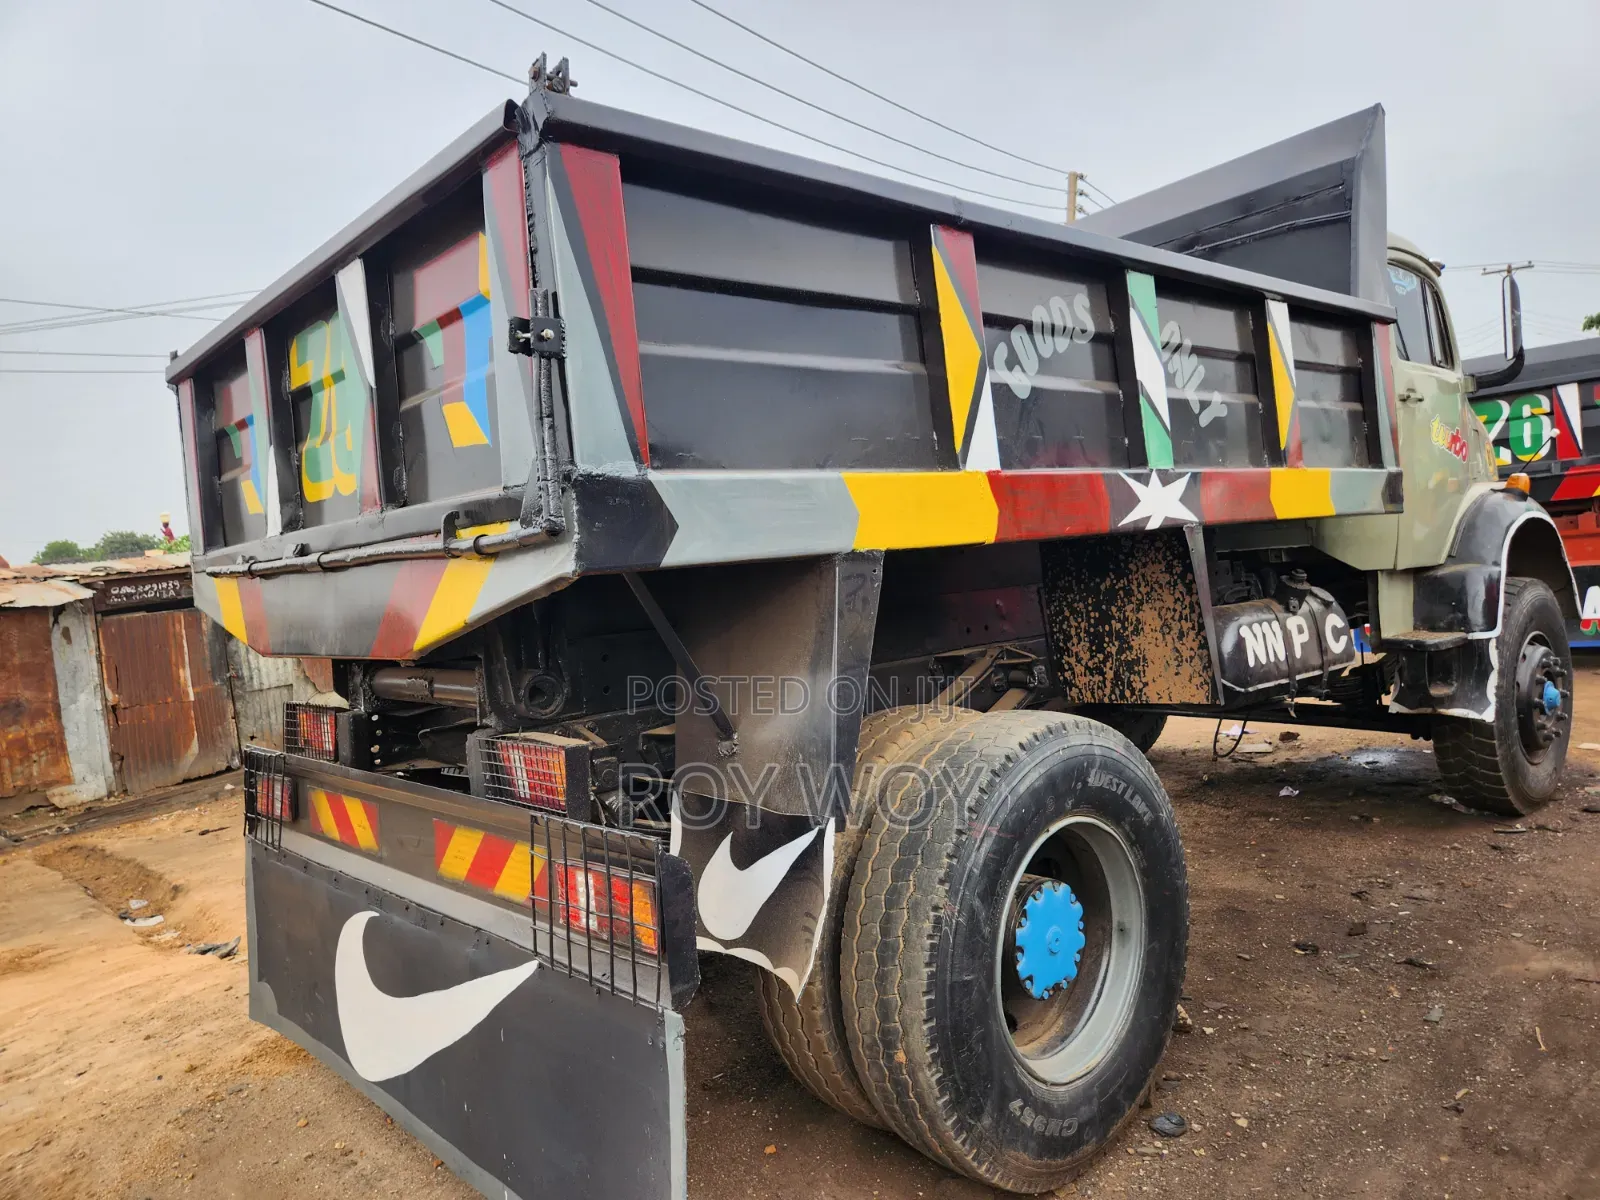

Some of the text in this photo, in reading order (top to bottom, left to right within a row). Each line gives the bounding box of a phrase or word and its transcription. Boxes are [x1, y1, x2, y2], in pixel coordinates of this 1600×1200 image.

[993, 292, 1095, 400] GOODS
[1160, 320, 1228, 428] ONLY
[1471, 393, 1551, 467] 26
